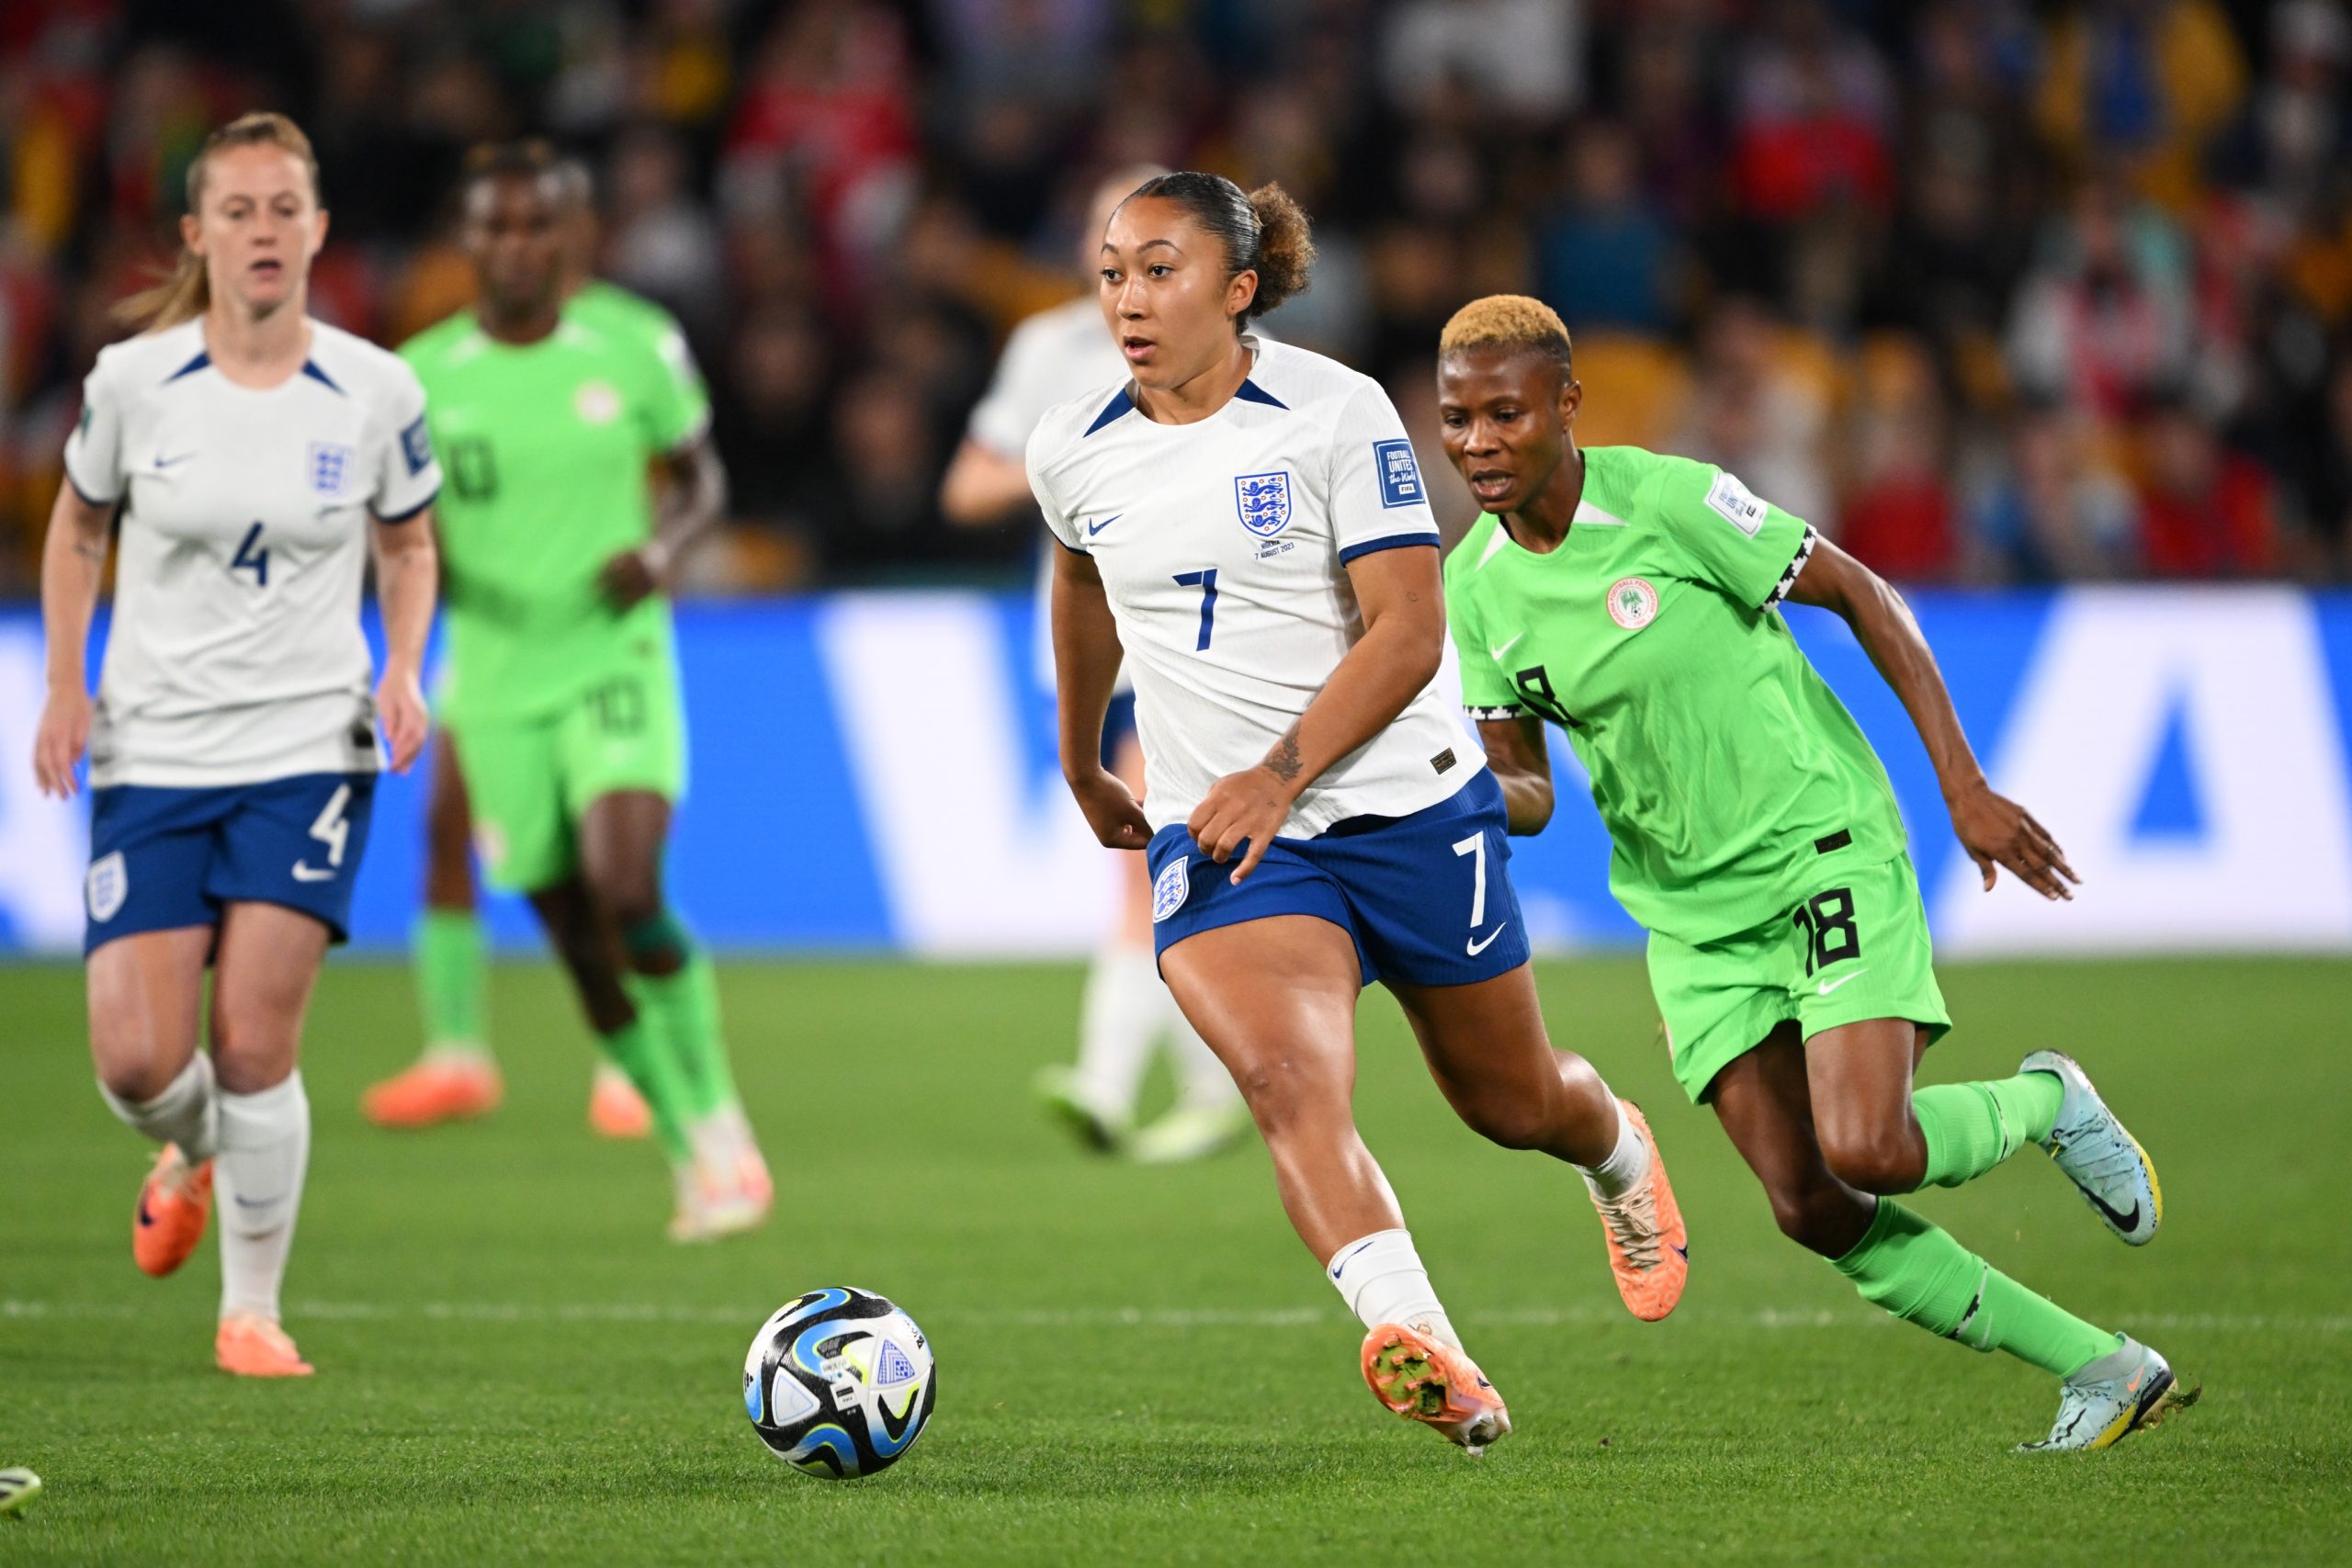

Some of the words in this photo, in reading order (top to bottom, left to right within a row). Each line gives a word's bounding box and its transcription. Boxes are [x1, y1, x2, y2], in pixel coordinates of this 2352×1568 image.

[1386, 450, 1411, 460] FOOTBALL
[1388, 459, 1414, 473] UNITES
[1388, 472, 1401, 485] the
[229, 521, 270, 588] 4
[1254, 552, 1259, 560] 7
[1261, 547, 1280, 558] AUGUST
[1280, 541, 1295, 553] 2023
[1170, 568, 1218, 652] 7
[309, 782, 352, 867] 4
[1451, 830, 1487, 929] 7
[1792, 887, 1861, 979] 18
